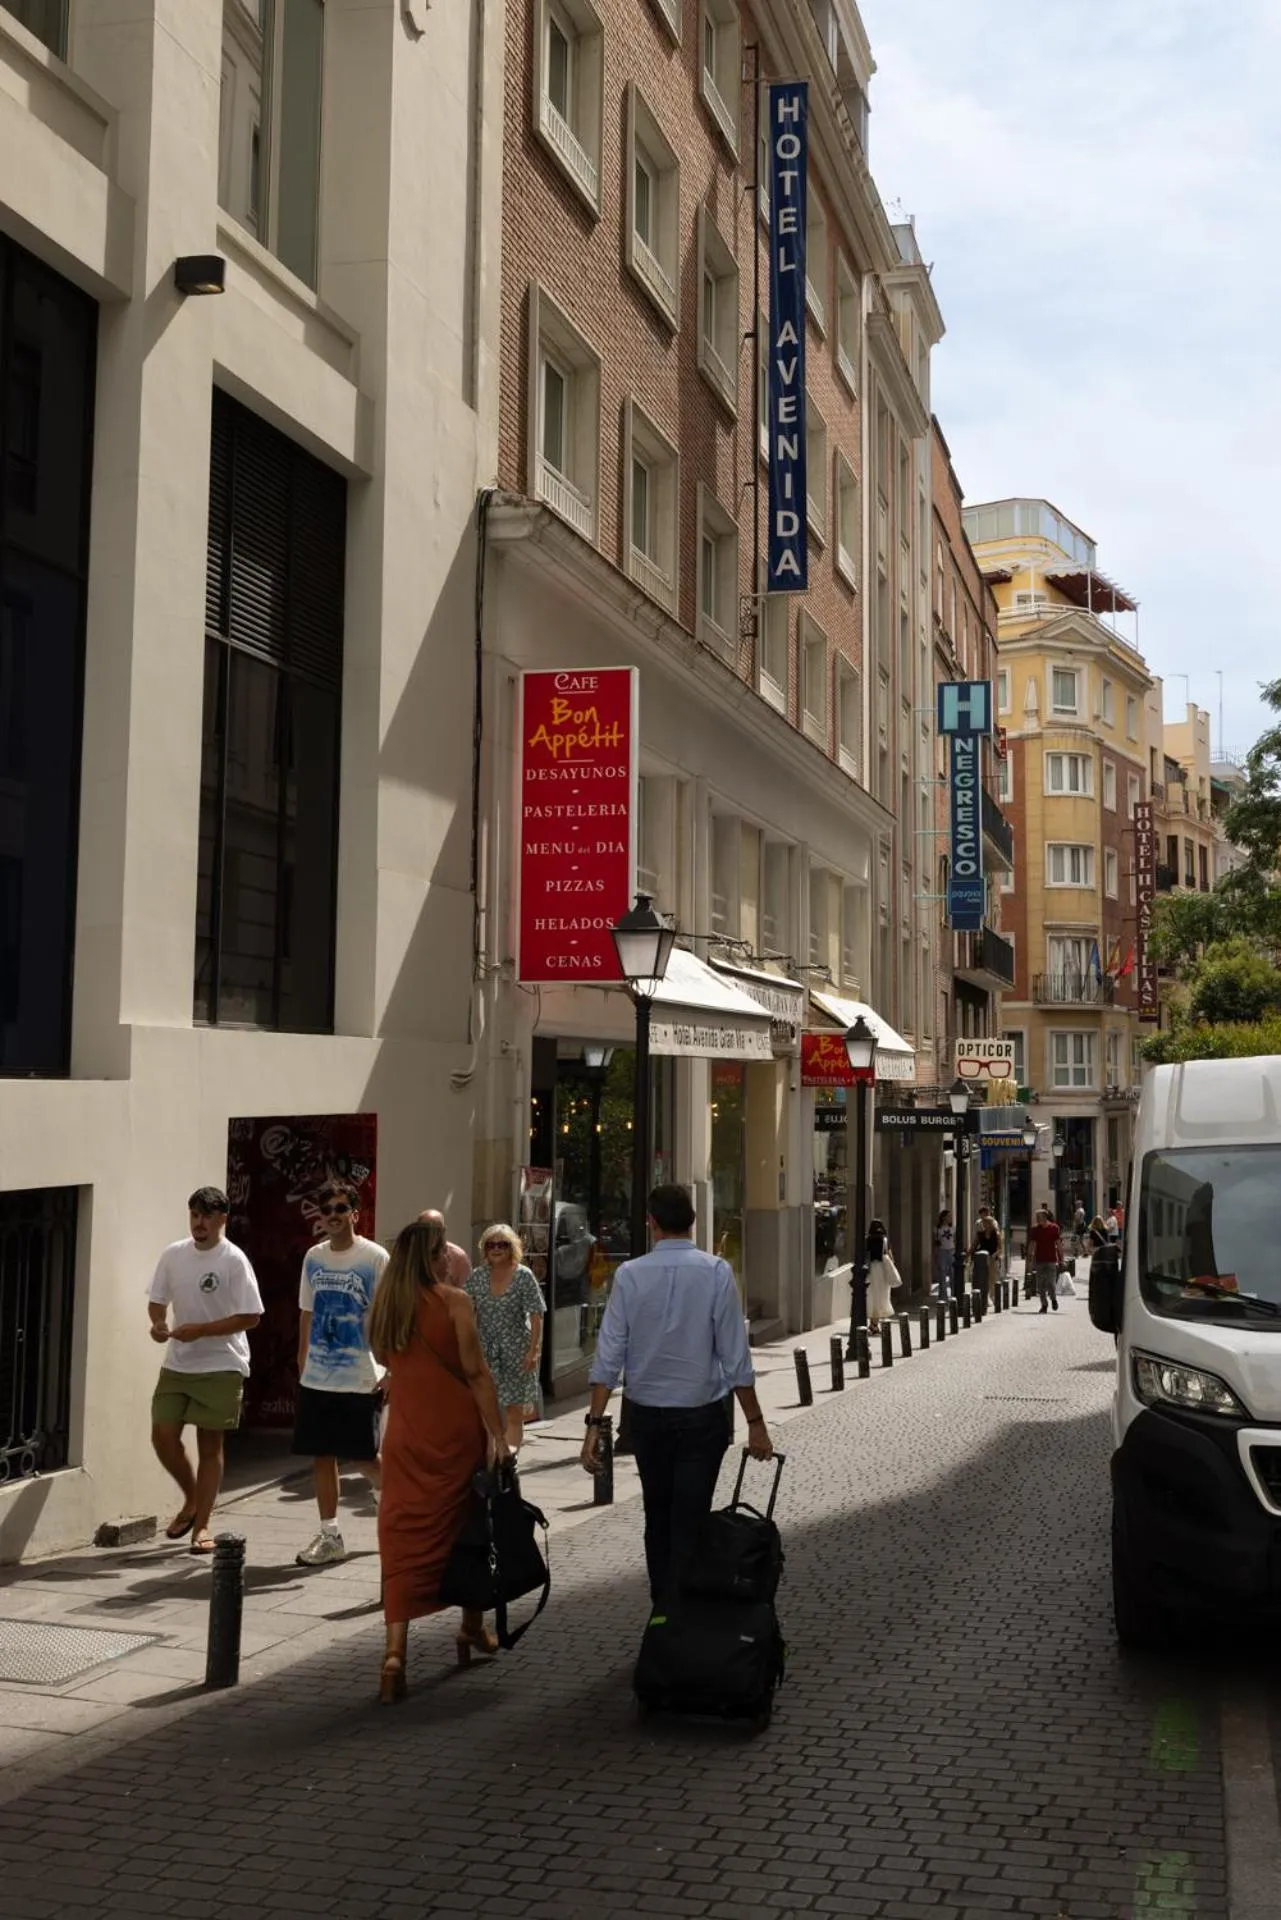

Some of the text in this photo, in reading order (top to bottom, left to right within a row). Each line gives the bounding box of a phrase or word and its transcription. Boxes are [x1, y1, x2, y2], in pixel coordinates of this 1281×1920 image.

[776, 97, 801, 577] HOTEL AVENIDA
[554, 672, 599, 690] CAFE
[551, 696, 599, 726] Bon
[528, 718, 625, 758] Appétit
[525, 765, 627, 781] DESAYUNOS
[523, 803, 628, 818] PASTELERIA
[955, 735, 978, 876] NEGRESCO
[1137, 806, 1151, 869] HOTEL
[525, 842, 576, 855] MENU
[595, 841, 625, 853] DIA
[545, 879, 605, 893] PIZZAS
[534, 917, 615, 930] HELADOS
[545, 955, 603, 968] CENAS
[958, 1043, 1012, 1057] OPTICOR
[882, 1115, 917, 1124] BOLUS
